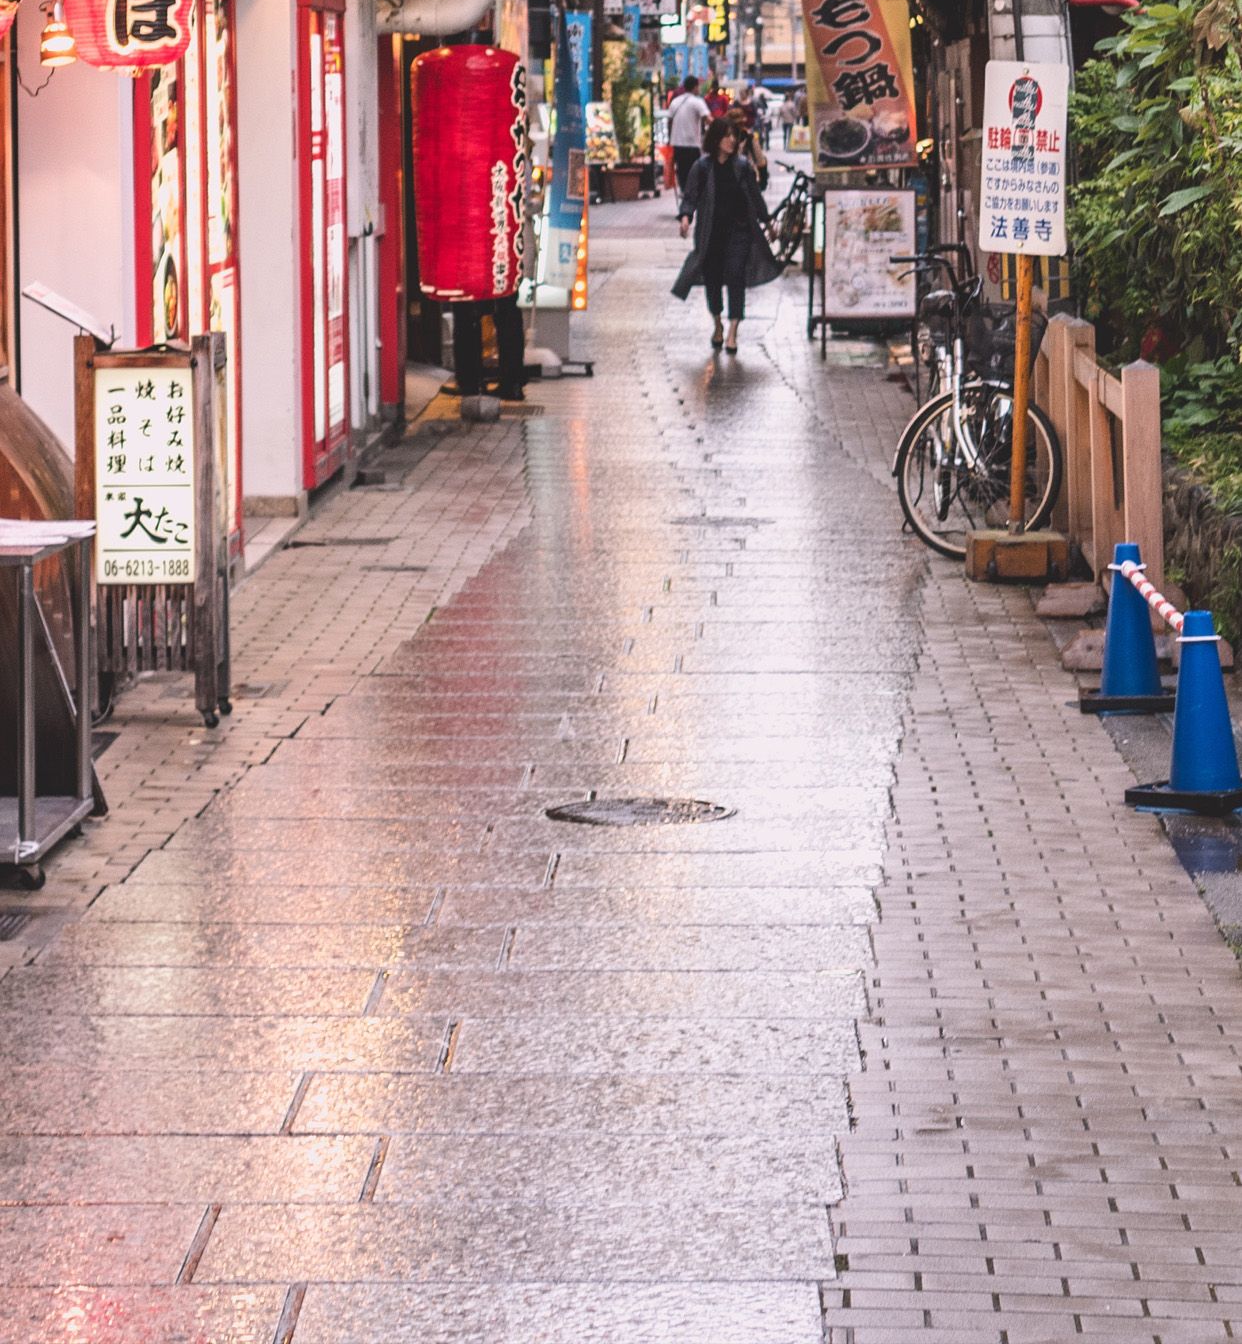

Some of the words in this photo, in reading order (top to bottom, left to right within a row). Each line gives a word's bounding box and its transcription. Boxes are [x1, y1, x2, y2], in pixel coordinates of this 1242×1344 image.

[986, 177, 1060, 195] ですからみなさんの
[990, 216, 1053, 242] 法善寺
[107, 387, 127, 474] 一品料理
[165, 380, 186, 474] お好み焼
[120, 497, 189, 544] 大たこ
[104, 560, 190, 576] 06-6213-1888
